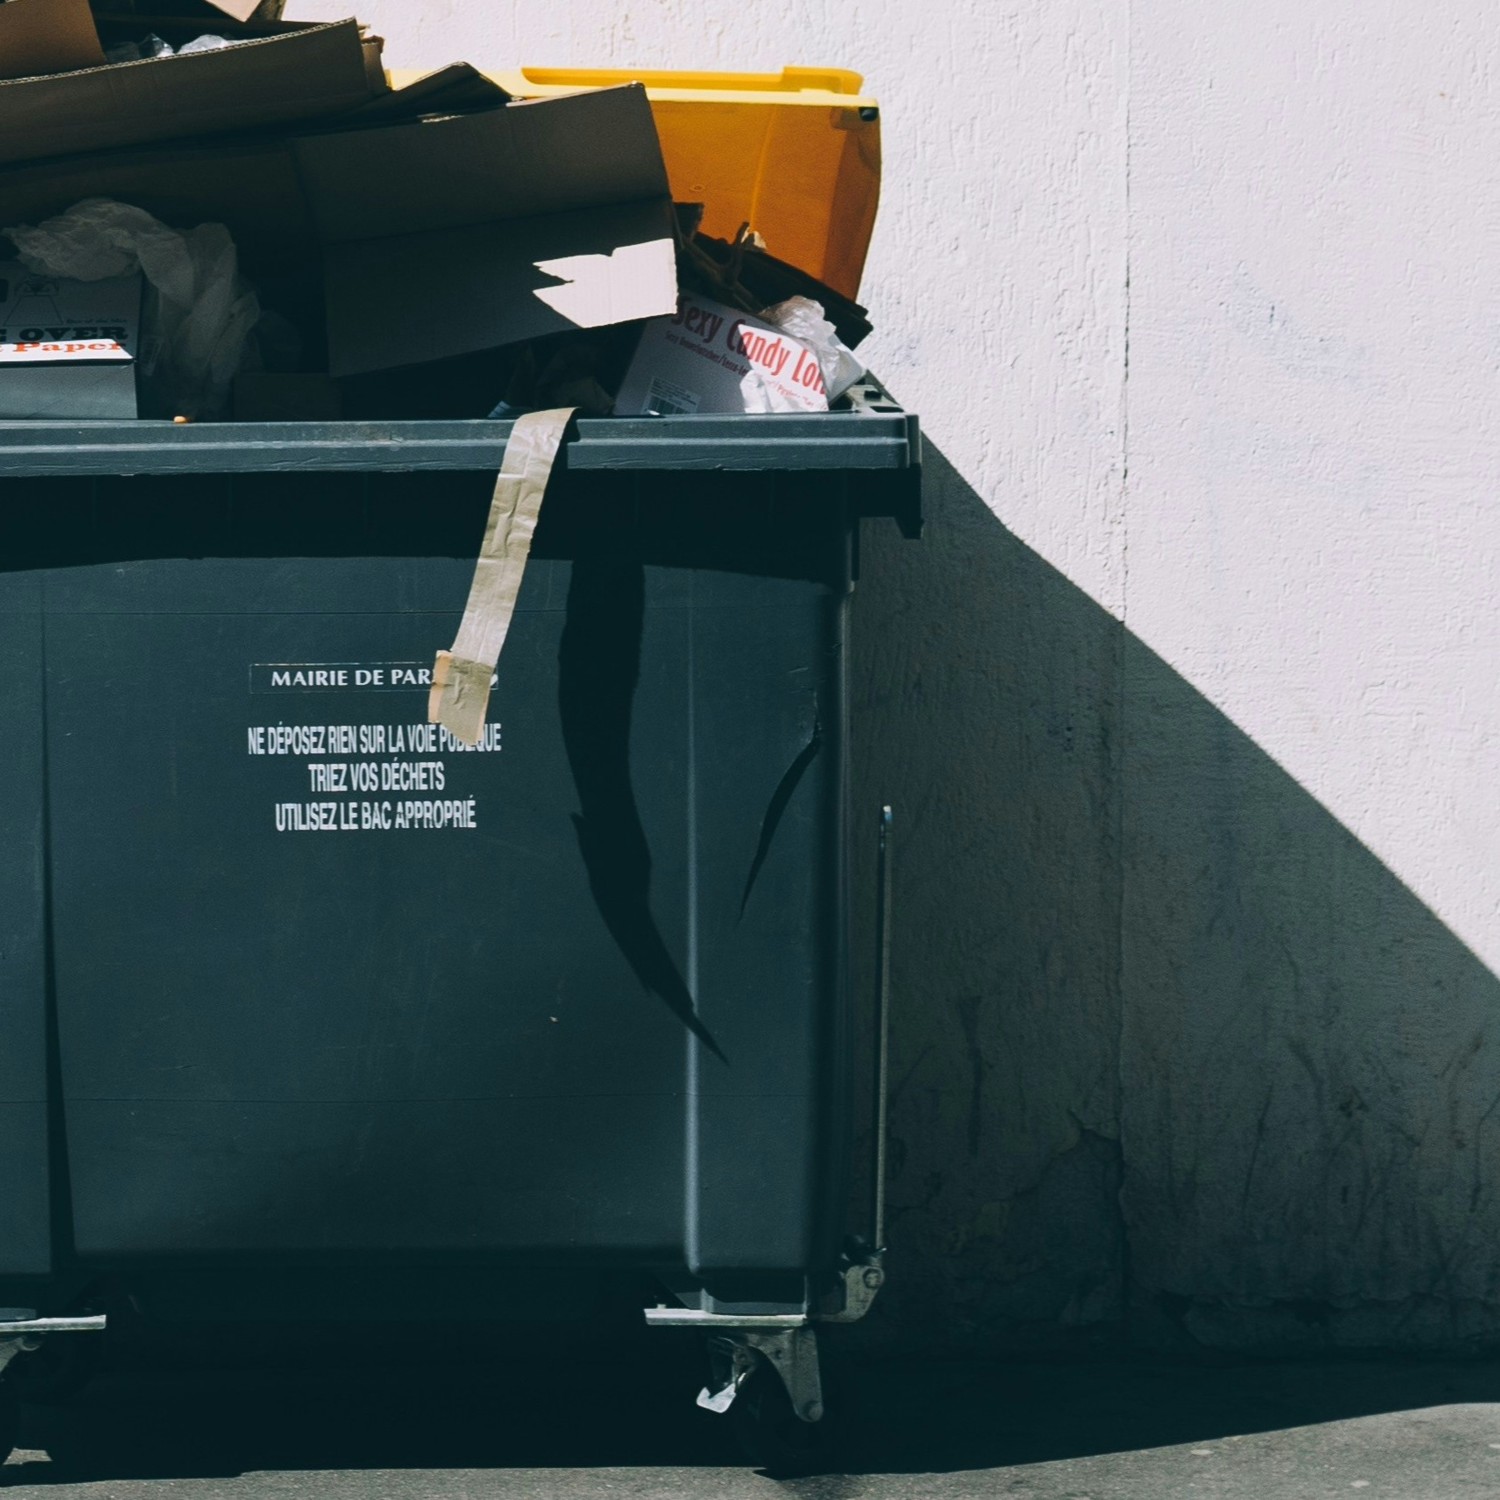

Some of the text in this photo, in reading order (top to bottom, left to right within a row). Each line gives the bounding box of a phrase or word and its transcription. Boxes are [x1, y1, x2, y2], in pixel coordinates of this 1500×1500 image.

[13, 342, 127, 353] Paper
[19, 327, 128, 341] OVER
[671, 297, 723, 343] Sexy
[728, 318, 790, 376] Candy
[271, 668, 432, 687] MAIRIE DE PAR
[248, 721, 501, 755] NE DÉPOSEZ RIEN SUR LA VOIE PUUE
[308, 756, 444, 791] TRIEZ VOS DÉCHETS
[275, 794, 477, 831] UTILISEZ LE BAC APPROPRIÉ
